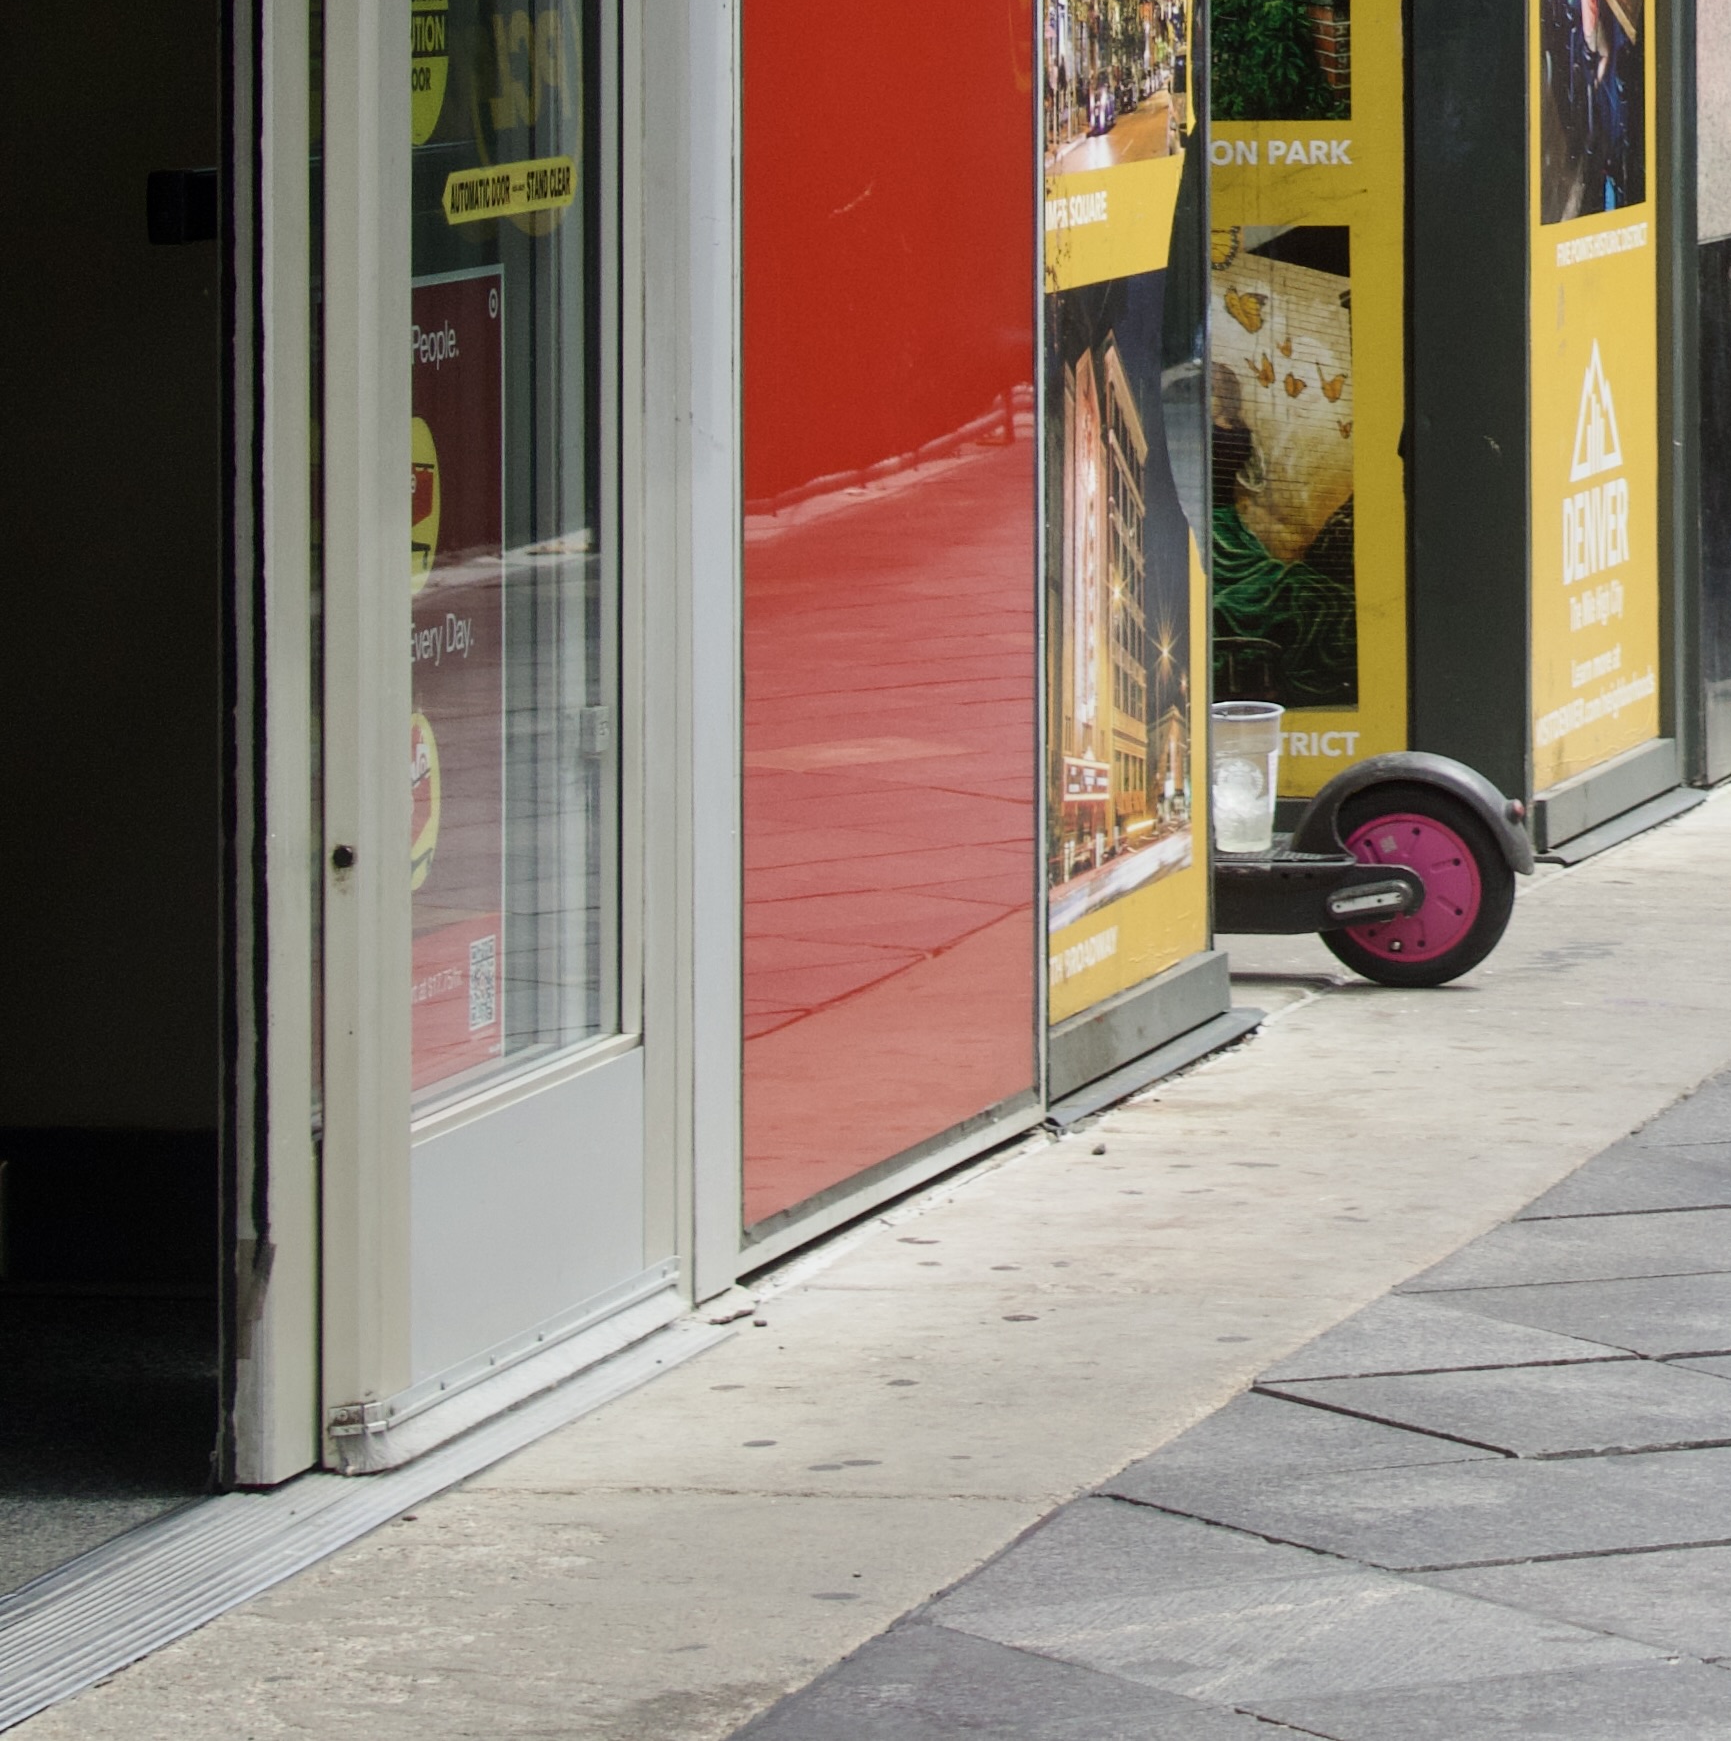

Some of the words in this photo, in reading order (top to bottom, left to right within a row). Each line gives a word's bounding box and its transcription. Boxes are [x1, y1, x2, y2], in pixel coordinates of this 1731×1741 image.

[1267, 139, 1353, 166] PARK
[450, 177, 491, 215] AUTOMATIC
[491, 174, 511, 207] DOOR
[526, 169, 549, 203] STAND
[549, 166, 571, 198] CLEAR
[1069, 190, 1108, 226] SQUARE
[411, 319, 460, 370] People.
[1562, 477, 1630, 586] DENVER
[445, 612, 474, 660] Day.
[1277, 731, 1361, 758] TRICT
[1063, 925, 1119, 979] BROADWAY
